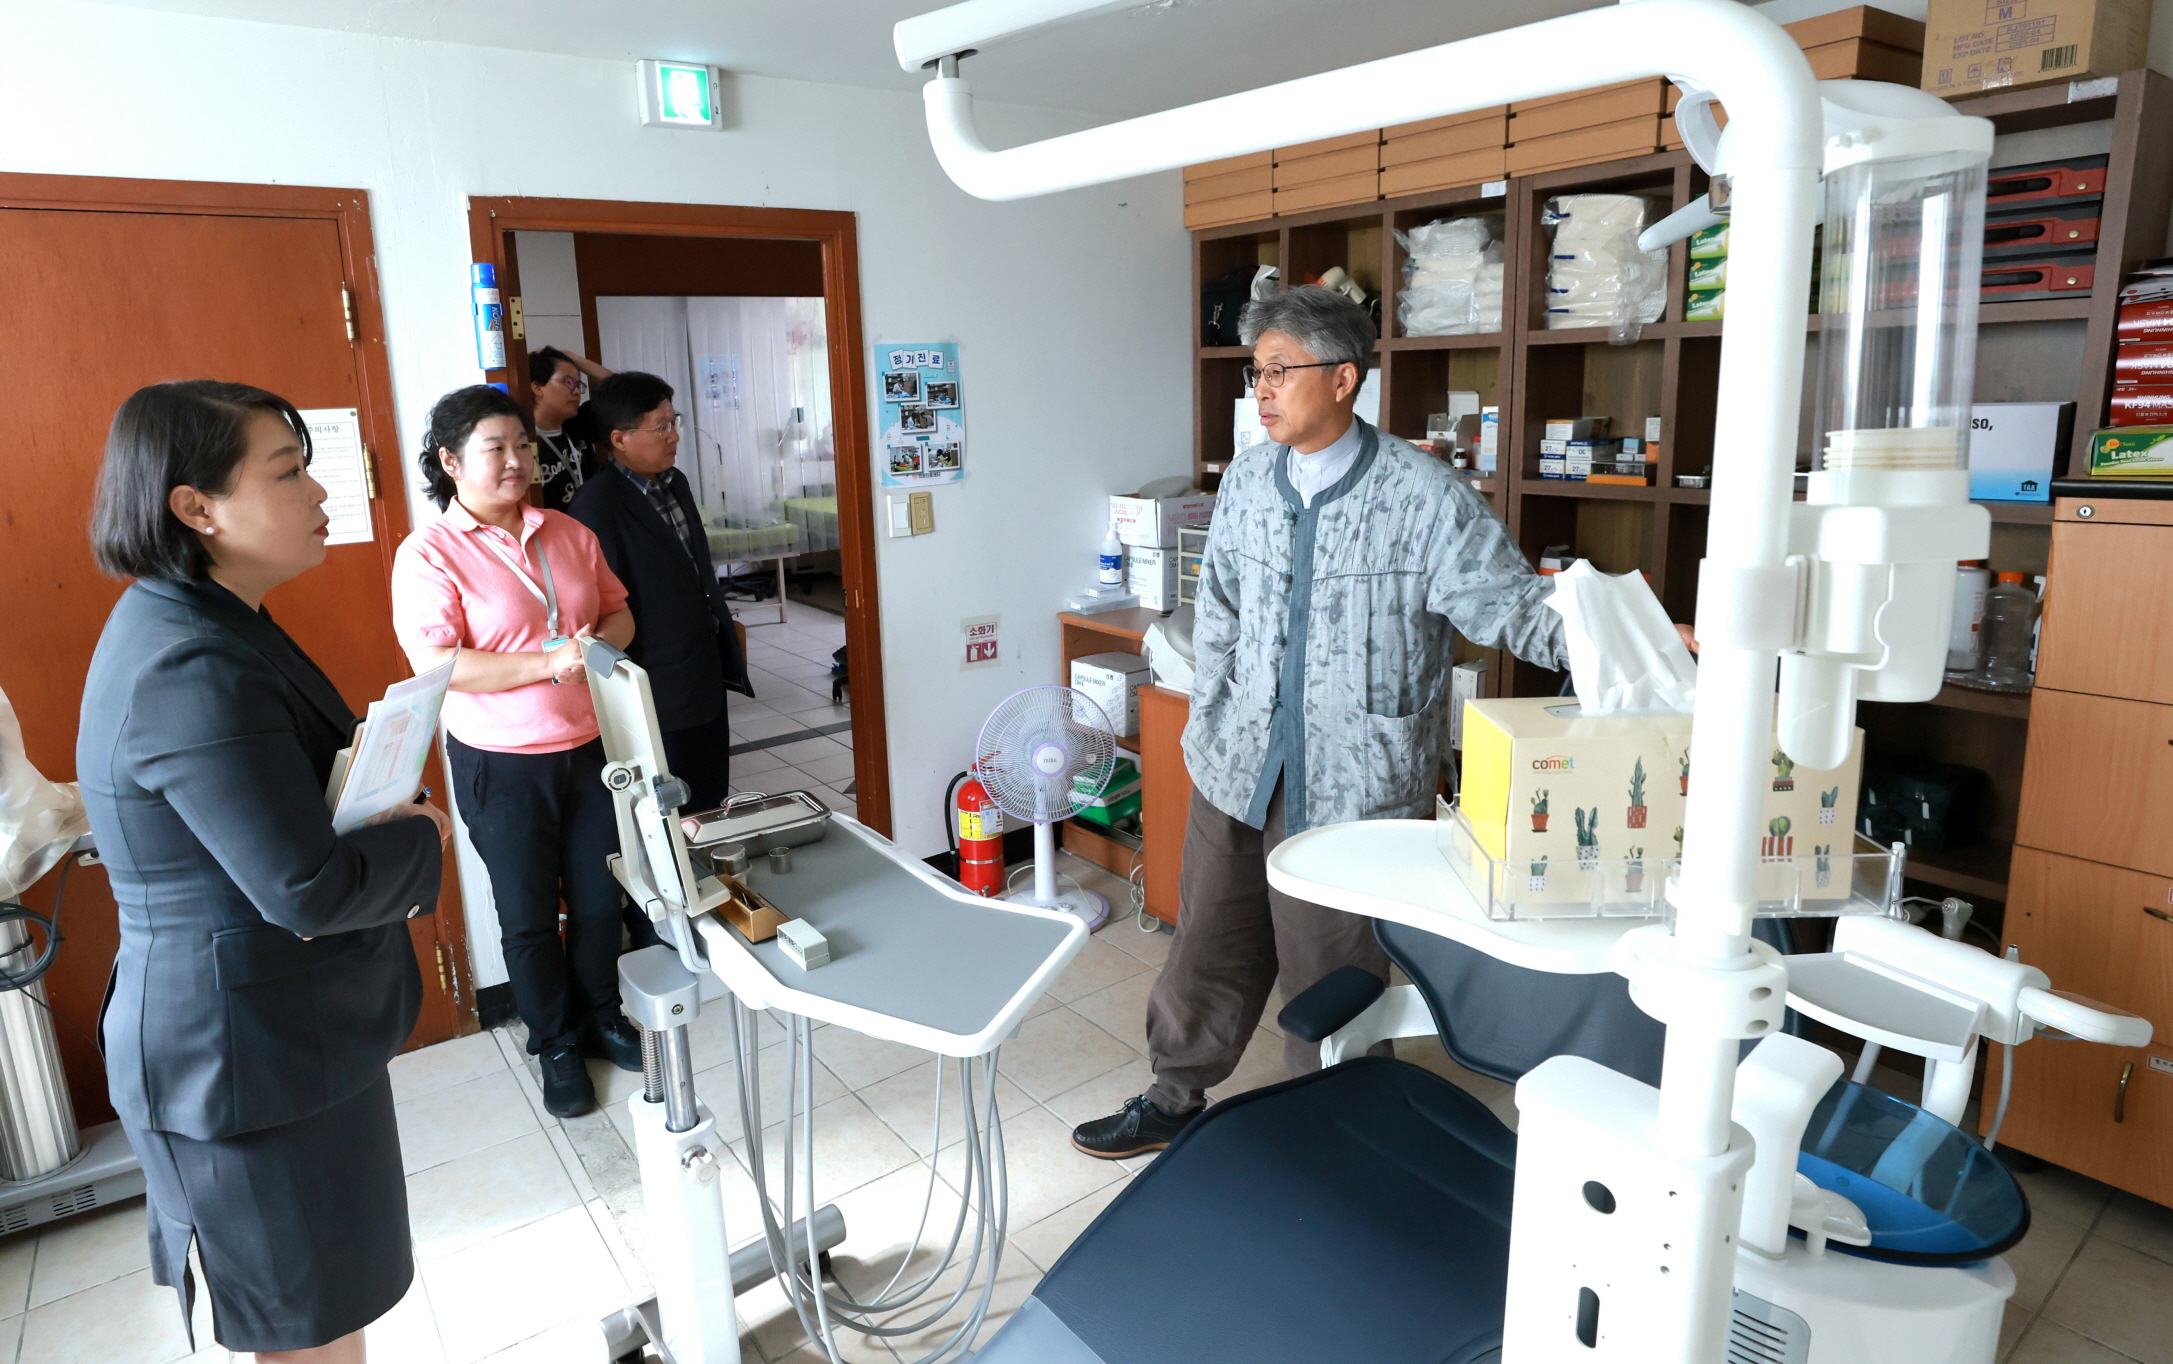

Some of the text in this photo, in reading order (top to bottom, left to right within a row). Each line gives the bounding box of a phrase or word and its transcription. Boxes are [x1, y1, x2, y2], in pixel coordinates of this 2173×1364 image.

[1998, 6, 2013, 20] M
[1954, 35, 1970, 44] LOT
[1972, 32, 1985, 40] NO
[1972, 38, 1994, 48] DATE
[1970, 46, 1992, 56] DATE
[893, 352, 941, 366] 정기진료
[2124, 400, 2151, 409] KF94
[1971, 418, 1994, 431] SO,
[2111, 449, 2149, 460] Latex
[969, 624, 995, 637] 소화기
[1074, 673, 1106, 687] CAPSULE MIXER
[1532, 756, 1575, 770] comet
